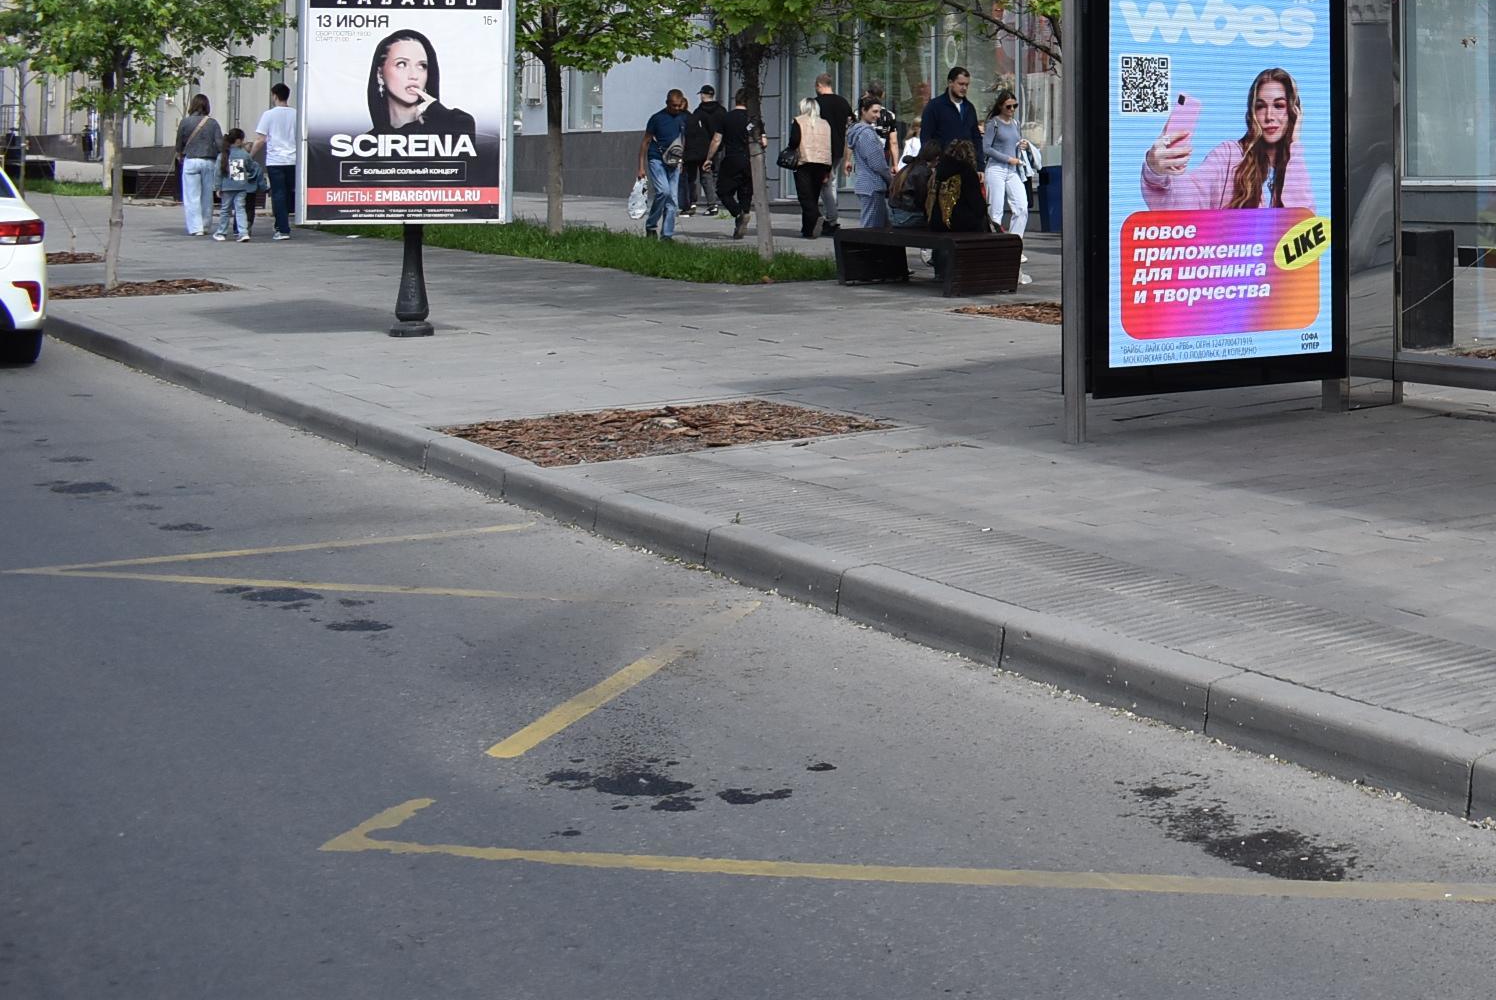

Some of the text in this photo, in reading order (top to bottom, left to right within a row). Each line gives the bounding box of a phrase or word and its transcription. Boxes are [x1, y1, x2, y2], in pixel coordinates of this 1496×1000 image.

[316, 14, 389, 28] 13 ИЮНЯ
[483, 16, 498, 26] 16+
[330, 133, 477, 157] SCIRENA
[363, 167, 396, 175] БОЛЬШОЙ
[396, 167, 428, 175] СОЛЬНЫЙ
[326, 190, 481, 202] БИЛЕТЫ: EMBARGOVILLA.RU
[1132, 224, 1197, 241] новое
[1282, 222, 1326, 265] LIKE
[1132, 243, 1264, 266] приложение
[1132, 262, 1267, 286] для шопинга
[1133, 283, 1271, 306] и творчества
[1301, 332, 1319, 340] СОФА
[1301, 342, 1320, 350] КУПЕР
